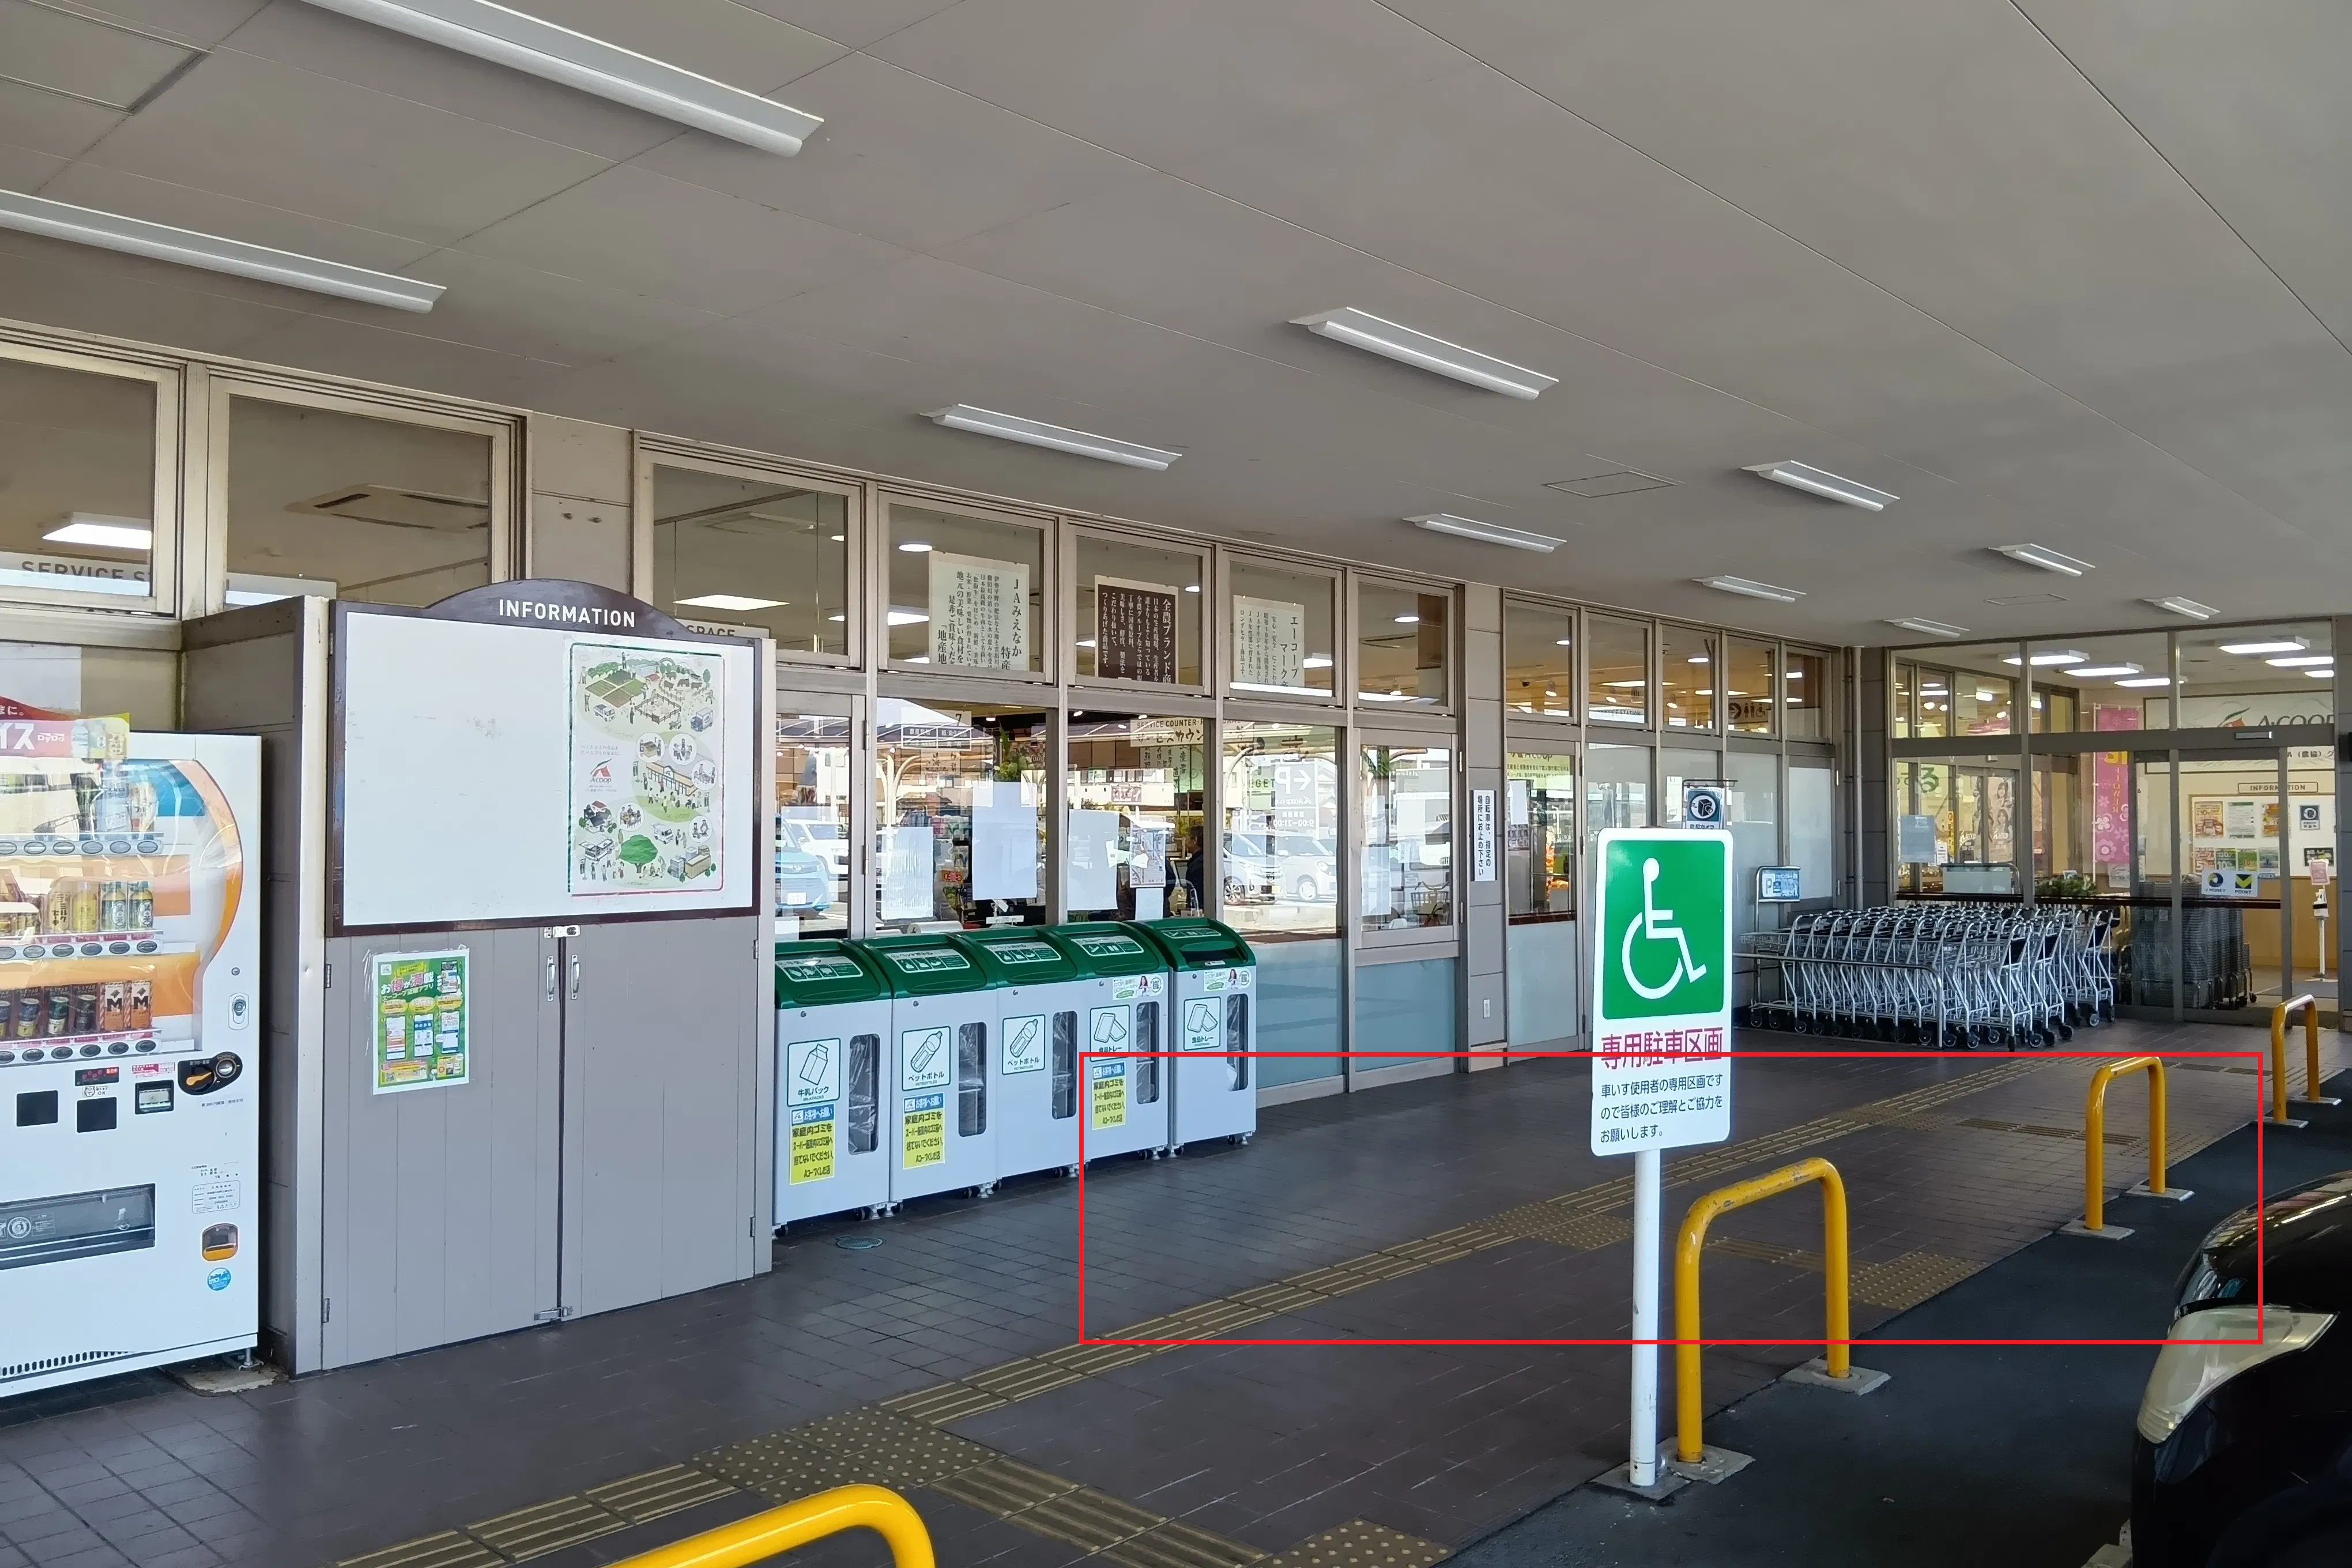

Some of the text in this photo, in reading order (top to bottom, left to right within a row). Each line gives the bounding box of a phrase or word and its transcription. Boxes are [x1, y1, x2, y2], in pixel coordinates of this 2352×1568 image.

[499, 599, 636, 628] INFORMATION
[1290, 616, 1299, 679] エーコープ
[1192, 1035, 1214, 1044] 食品トレー
[1601, 1027, 1723, 1070] 専用駐車区画
[1007, 1056, 1040, 1066] ペットボトル
[908, 1071, 944, 1082] ペットボトル
[1601, 1073, 1723, 1098] 車いす使用者の専用区画です
[798, 1085, 830, 1096] 牛乳パック
[1601, 1095, 1722, 1120] ので皆様のご理解とご協力を
[792, 1125, 833, 1138] 家庭内ゴミを
[1600, 1124, 1664, 1143] お願いします。
